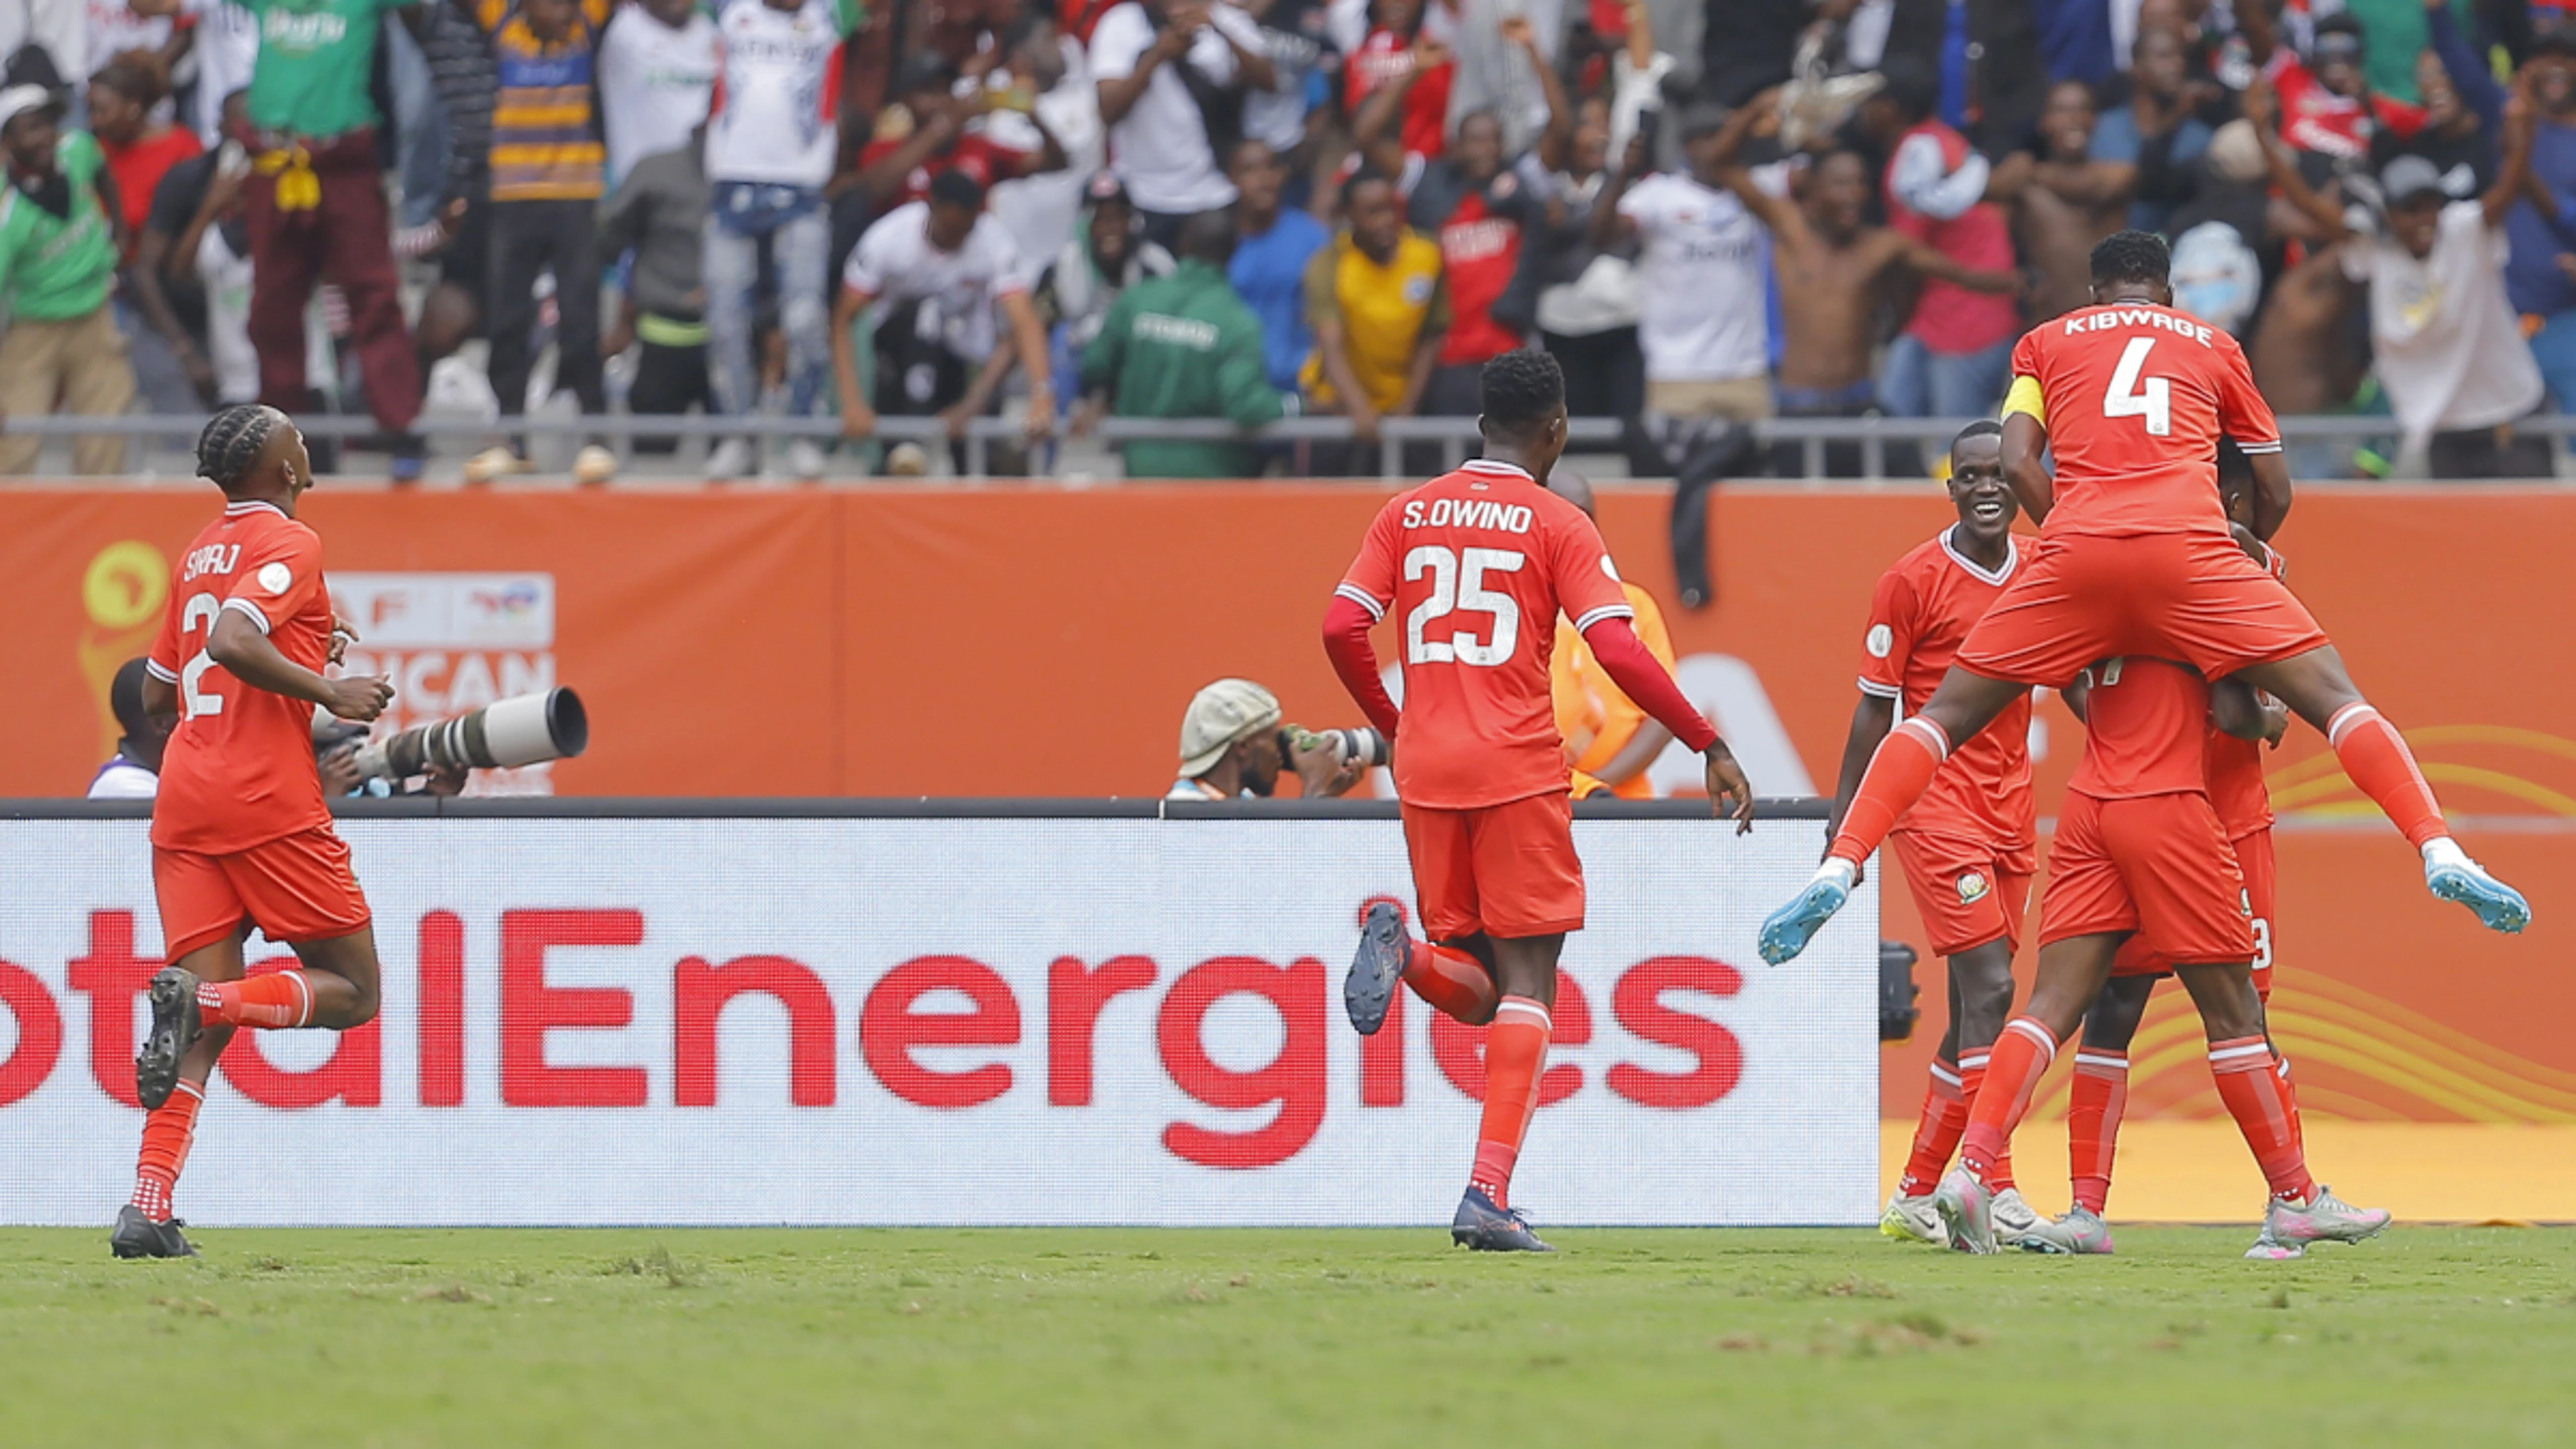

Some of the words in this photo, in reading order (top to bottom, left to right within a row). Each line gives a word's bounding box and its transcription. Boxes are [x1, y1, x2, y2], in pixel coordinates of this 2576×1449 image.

[2064, 309, 2214, 349] KIBWAGE
[2103, 337, 2171, 436] 4
[1403, 498, 1532, 534] S.OWINO
[1403, 545, 1526, 666] 25
[182, 592, 224, 722] 2
[325, 649, 557, 714] ICAN
[2251, 918, 2273, 970] 3
